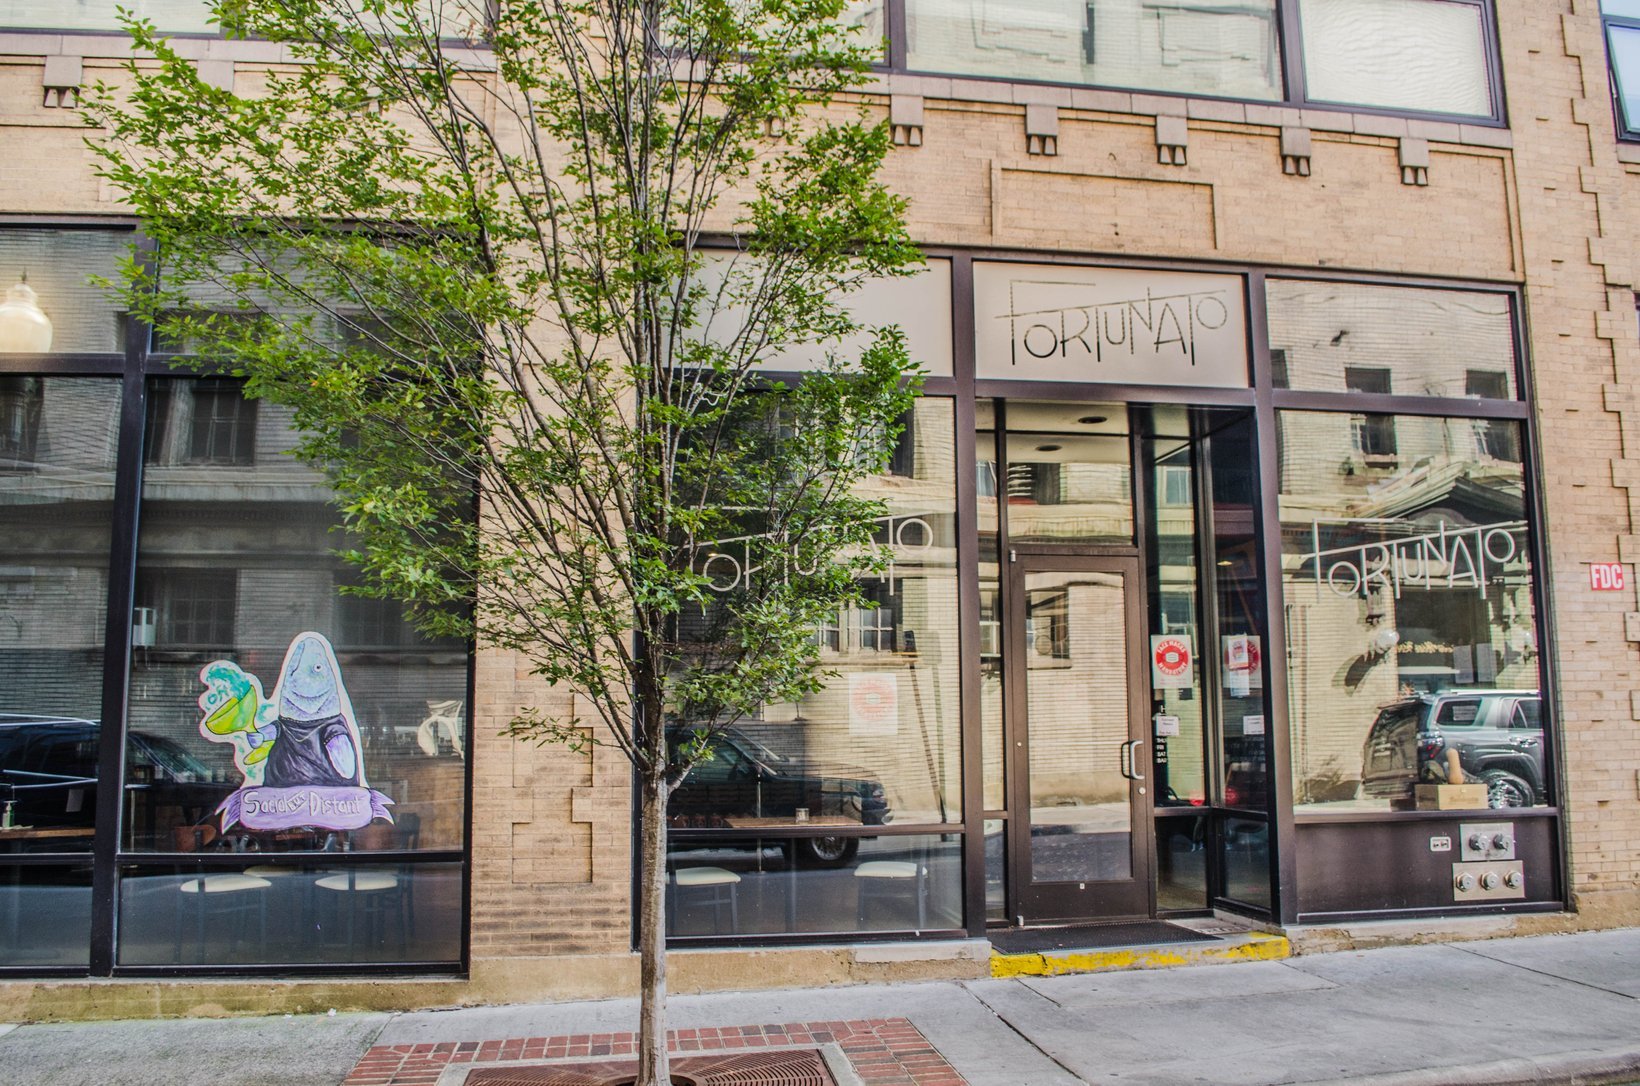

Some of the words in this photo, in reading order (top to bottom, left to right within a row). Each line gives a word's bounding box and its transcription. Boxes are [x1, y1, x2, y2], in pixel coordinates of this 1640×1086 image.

[995, 280, 1227, 366] FORTUNATO
[1301, 518, 1517, 602] FORTUNATO
[1591, 564, 1623, 589] FDC
[309, 791, 361, 816] Distant
